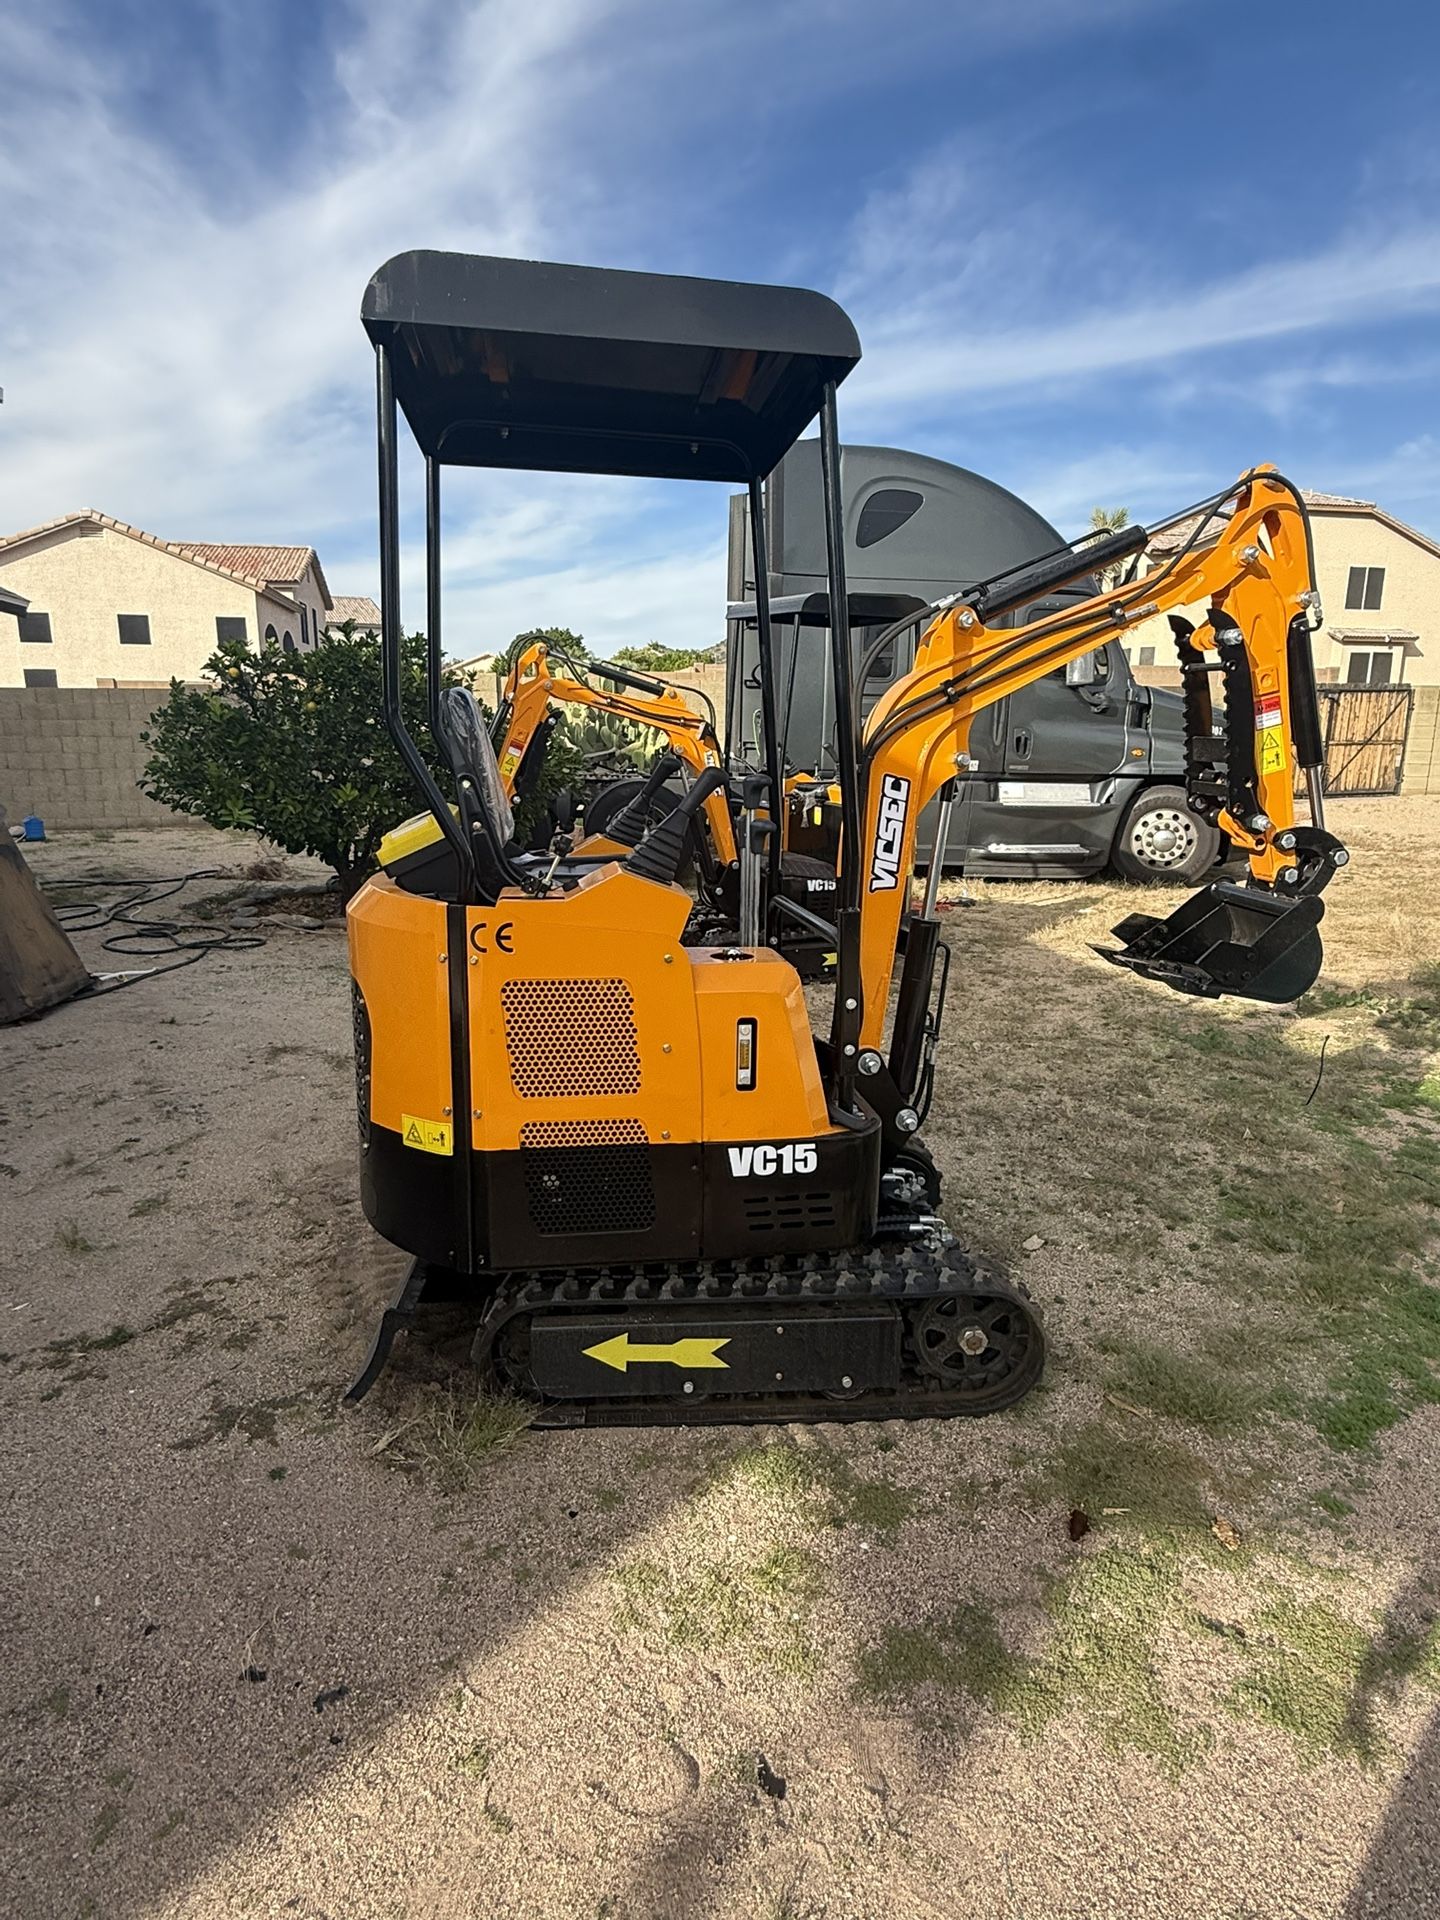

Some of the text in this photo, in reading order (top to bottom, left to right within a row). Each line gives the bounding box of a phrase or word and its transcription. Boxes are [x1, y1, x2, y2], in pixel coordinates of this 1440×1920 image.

[871, 775, 910, 891] VICSEC
[807, 879, 837, 892] VC15
[470, 922, 514, 953] CE
[727, 1143, 818, 1177] VC15
